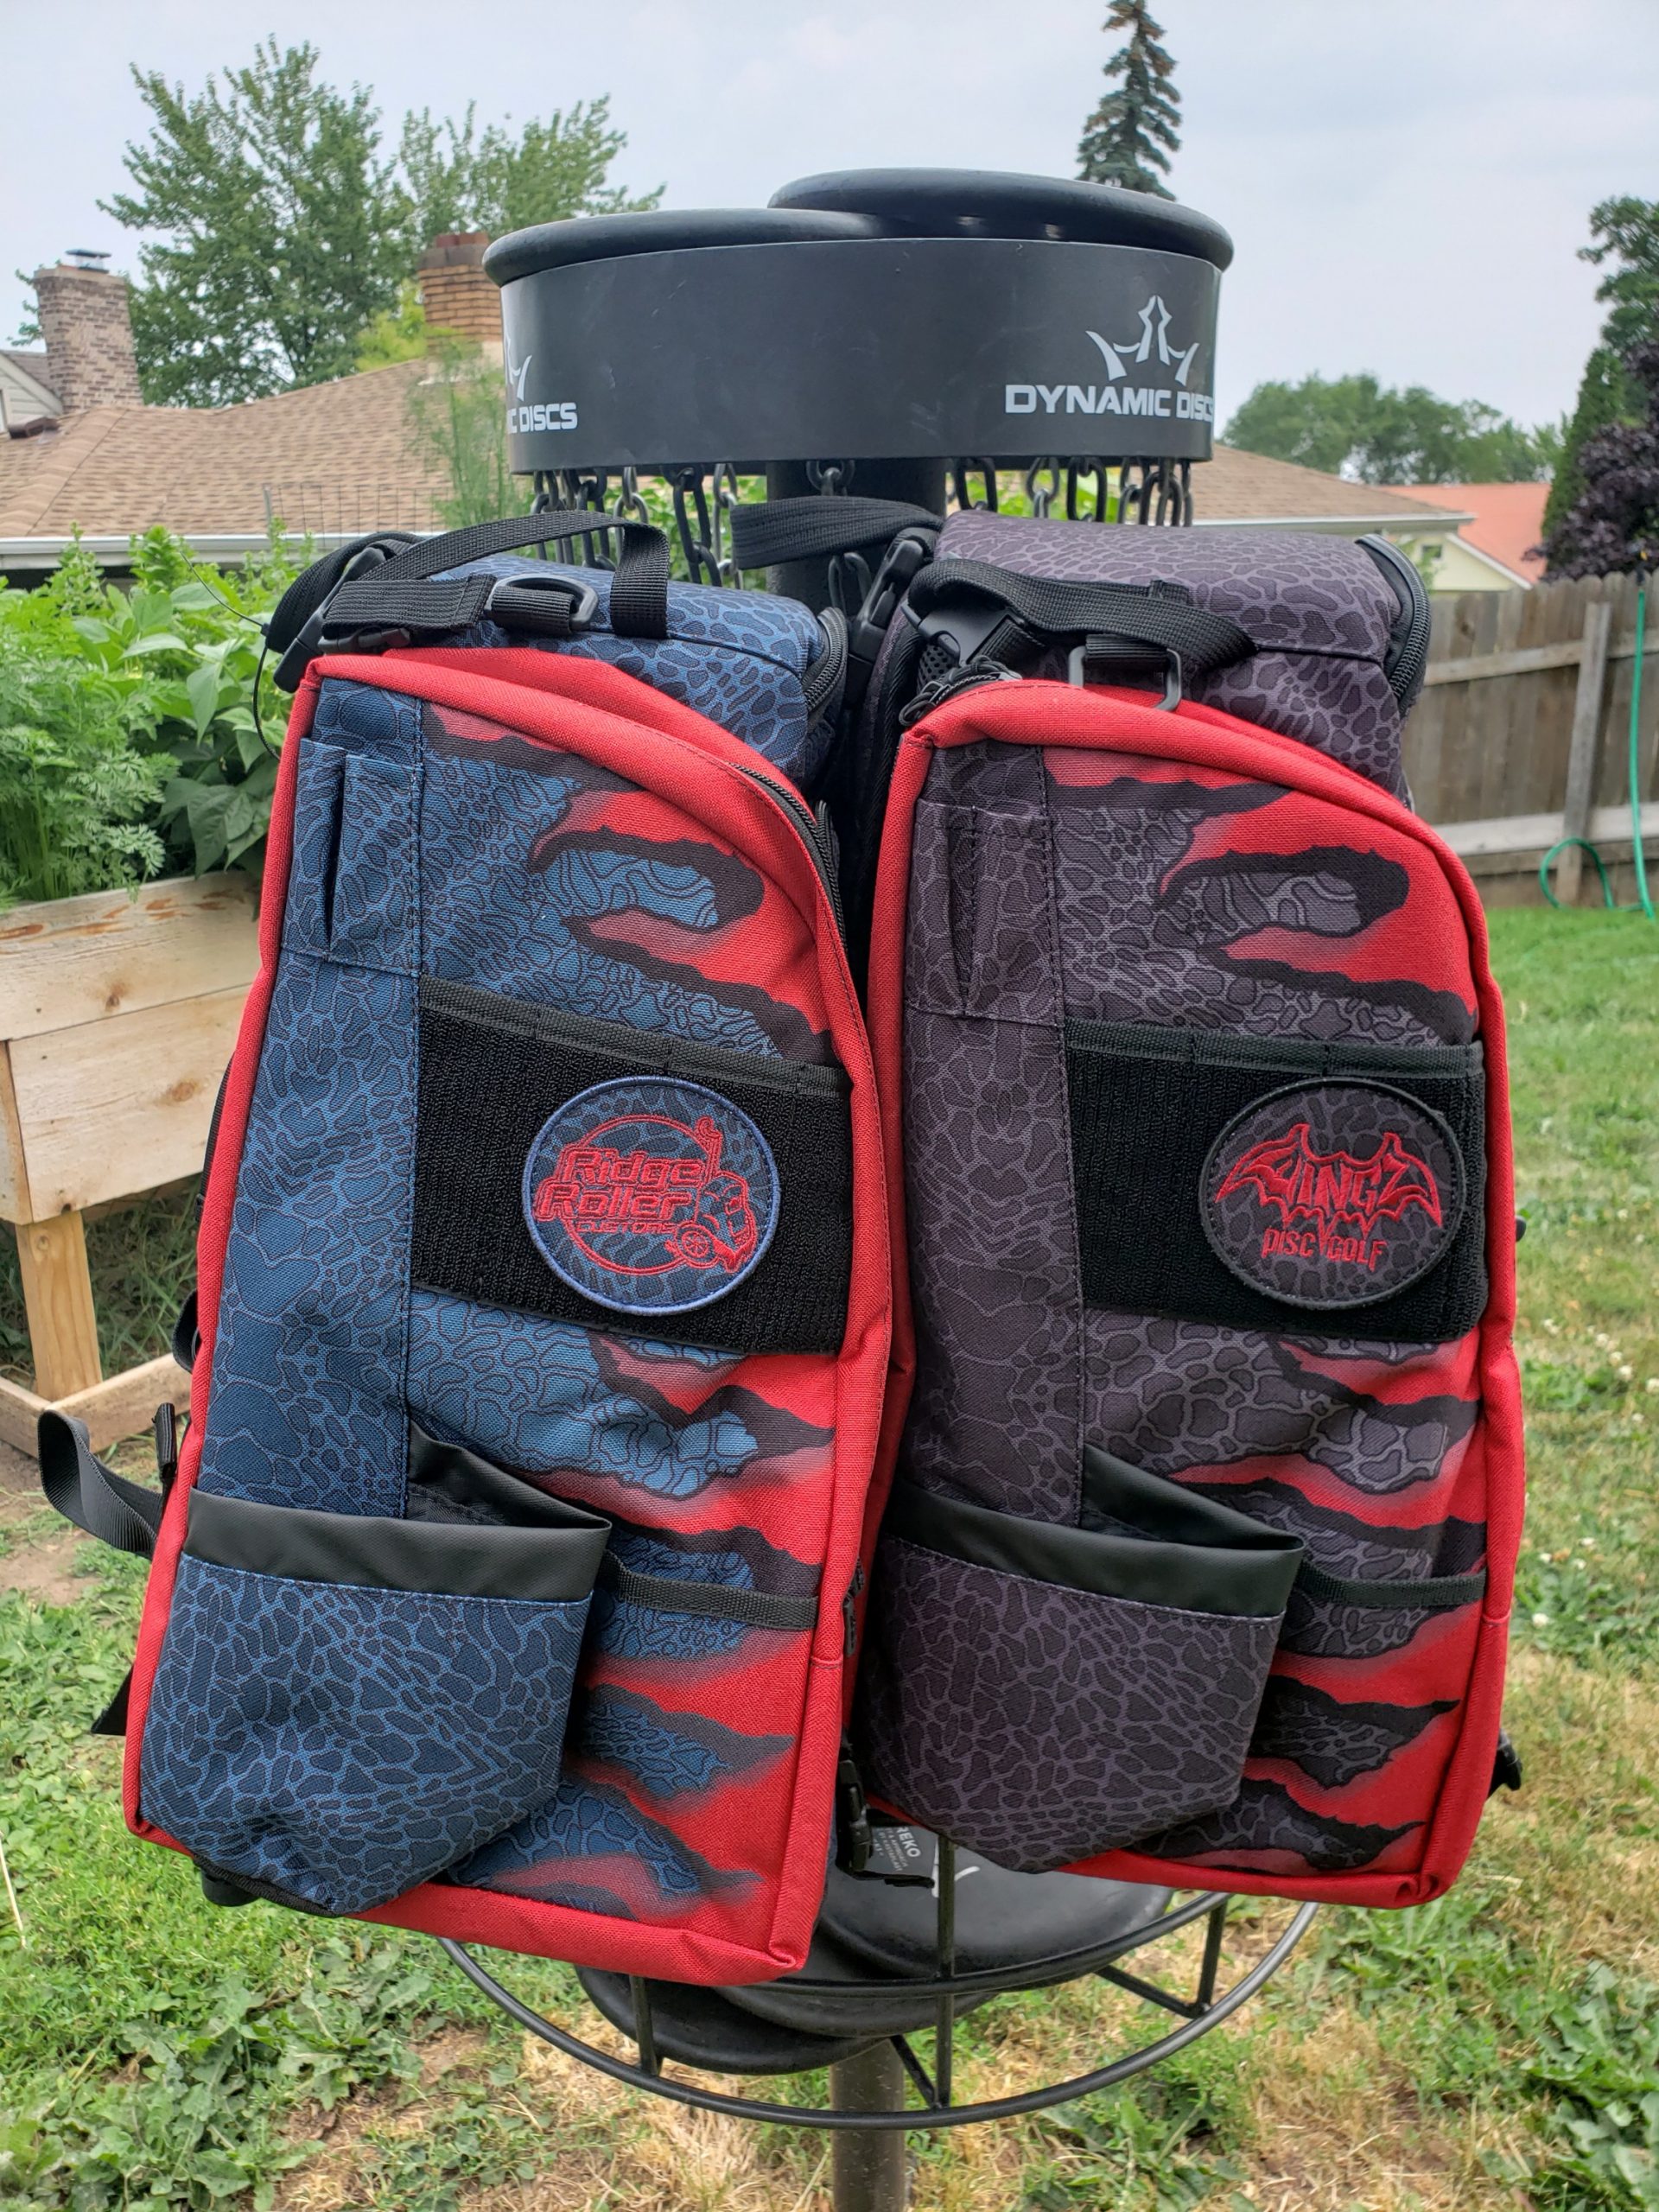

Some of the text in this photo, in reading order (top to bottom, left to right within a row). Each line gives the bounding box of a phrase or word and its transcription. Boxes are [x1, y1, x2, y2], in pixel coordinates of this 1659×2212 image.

[518, 402, 578, 432] DISCS
[1005, 385, 1171, 417] DYNAMIC
[557, 1147, 703, 1191] Ridge
[534, 1180, 693, 1222] Roller
[1262, 1226, 1388, 1273] DISC GOLF
